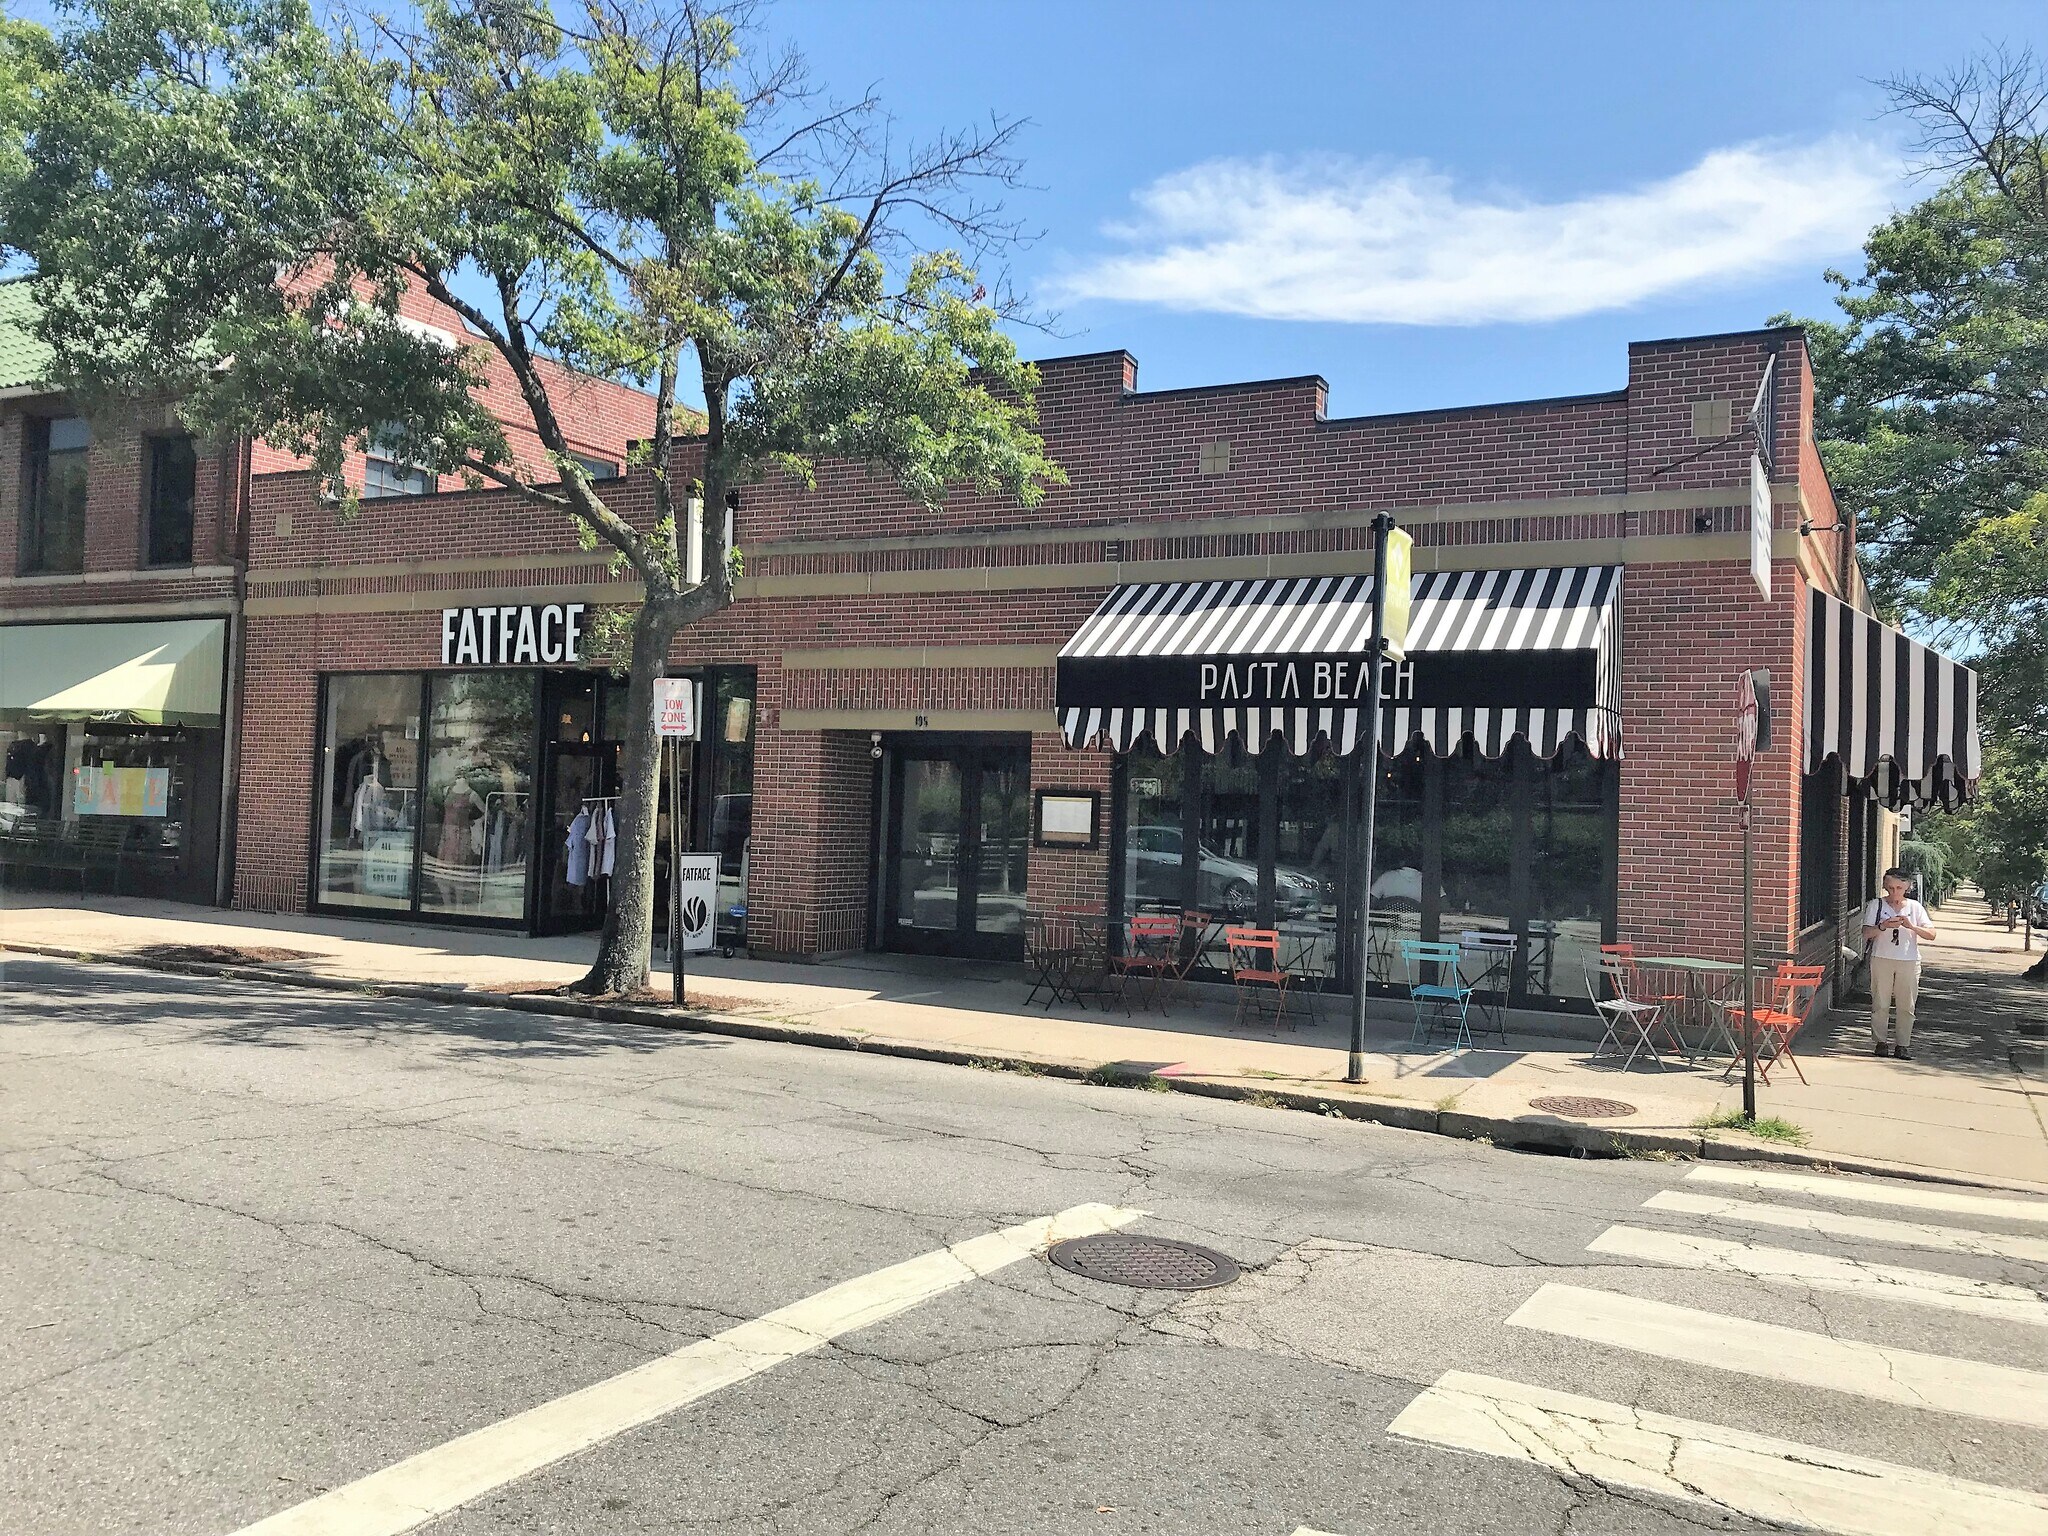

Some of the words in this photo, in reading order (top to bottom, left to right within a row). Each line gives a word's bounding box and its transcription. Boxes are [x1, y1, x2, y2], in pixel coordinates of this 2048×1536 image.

[442, 604, 584, 664] FATFACE
[1200, 662, 1300, 700] PASTA
[1313, 661, 1414, 700] BEACH
[664, 699, 683, 710] TOW
[661, 712, 686, 723] ZONE
[682, 867, 711, 881] FATFACE
